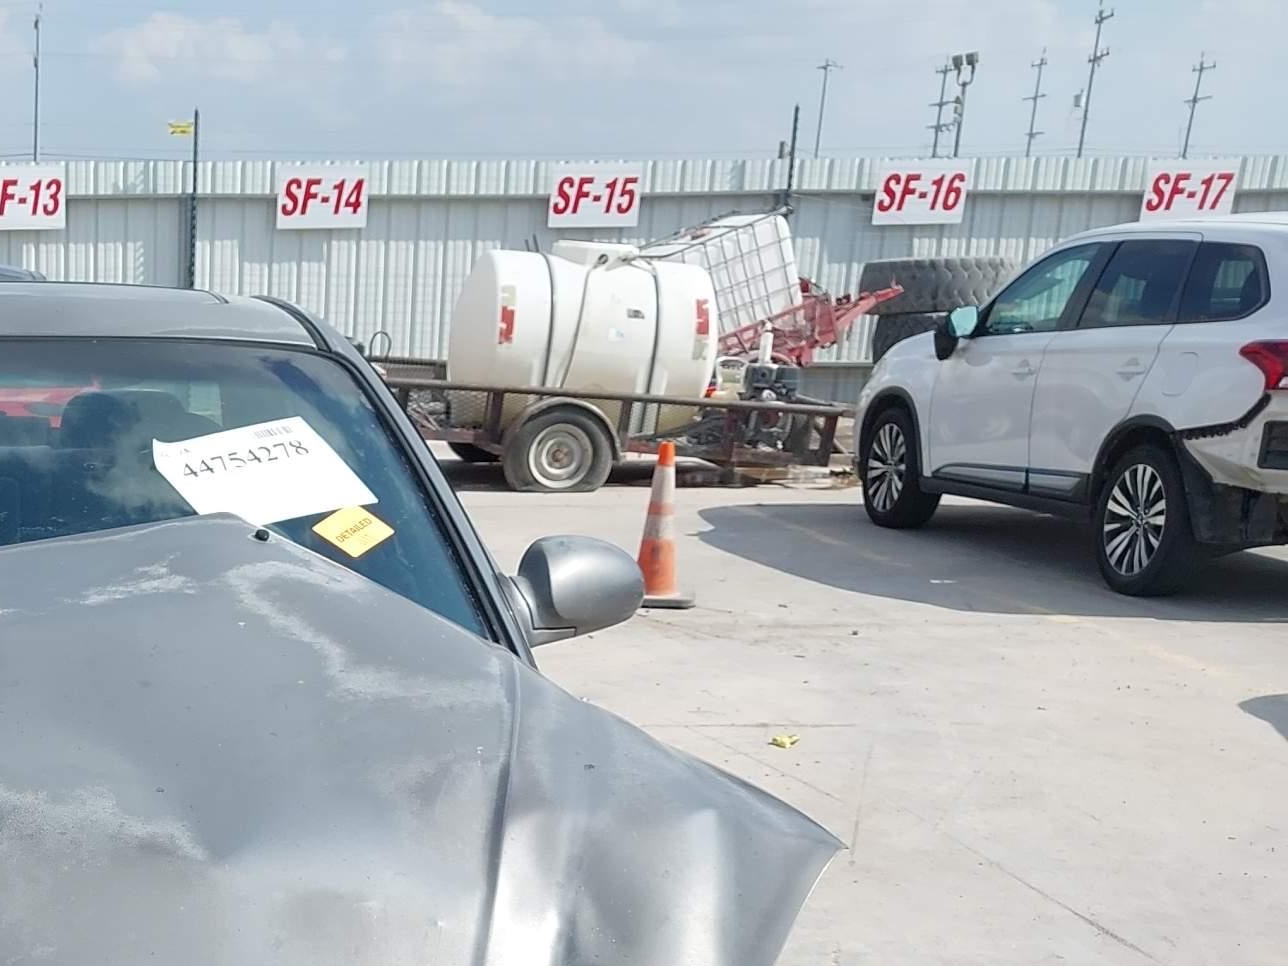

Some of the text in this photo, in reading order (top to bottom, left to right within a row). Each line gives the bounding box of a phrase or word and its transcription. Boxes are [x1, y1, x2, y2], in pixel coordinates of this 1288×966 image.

[281, 177, 365, 216] SF-14
[552, 176, 640, 215] SF-15
[877, 172, 966, 213] SF-16
[1145, 172, 1235, 212] SF-17
[183, 439, 310, 477] 44754278
